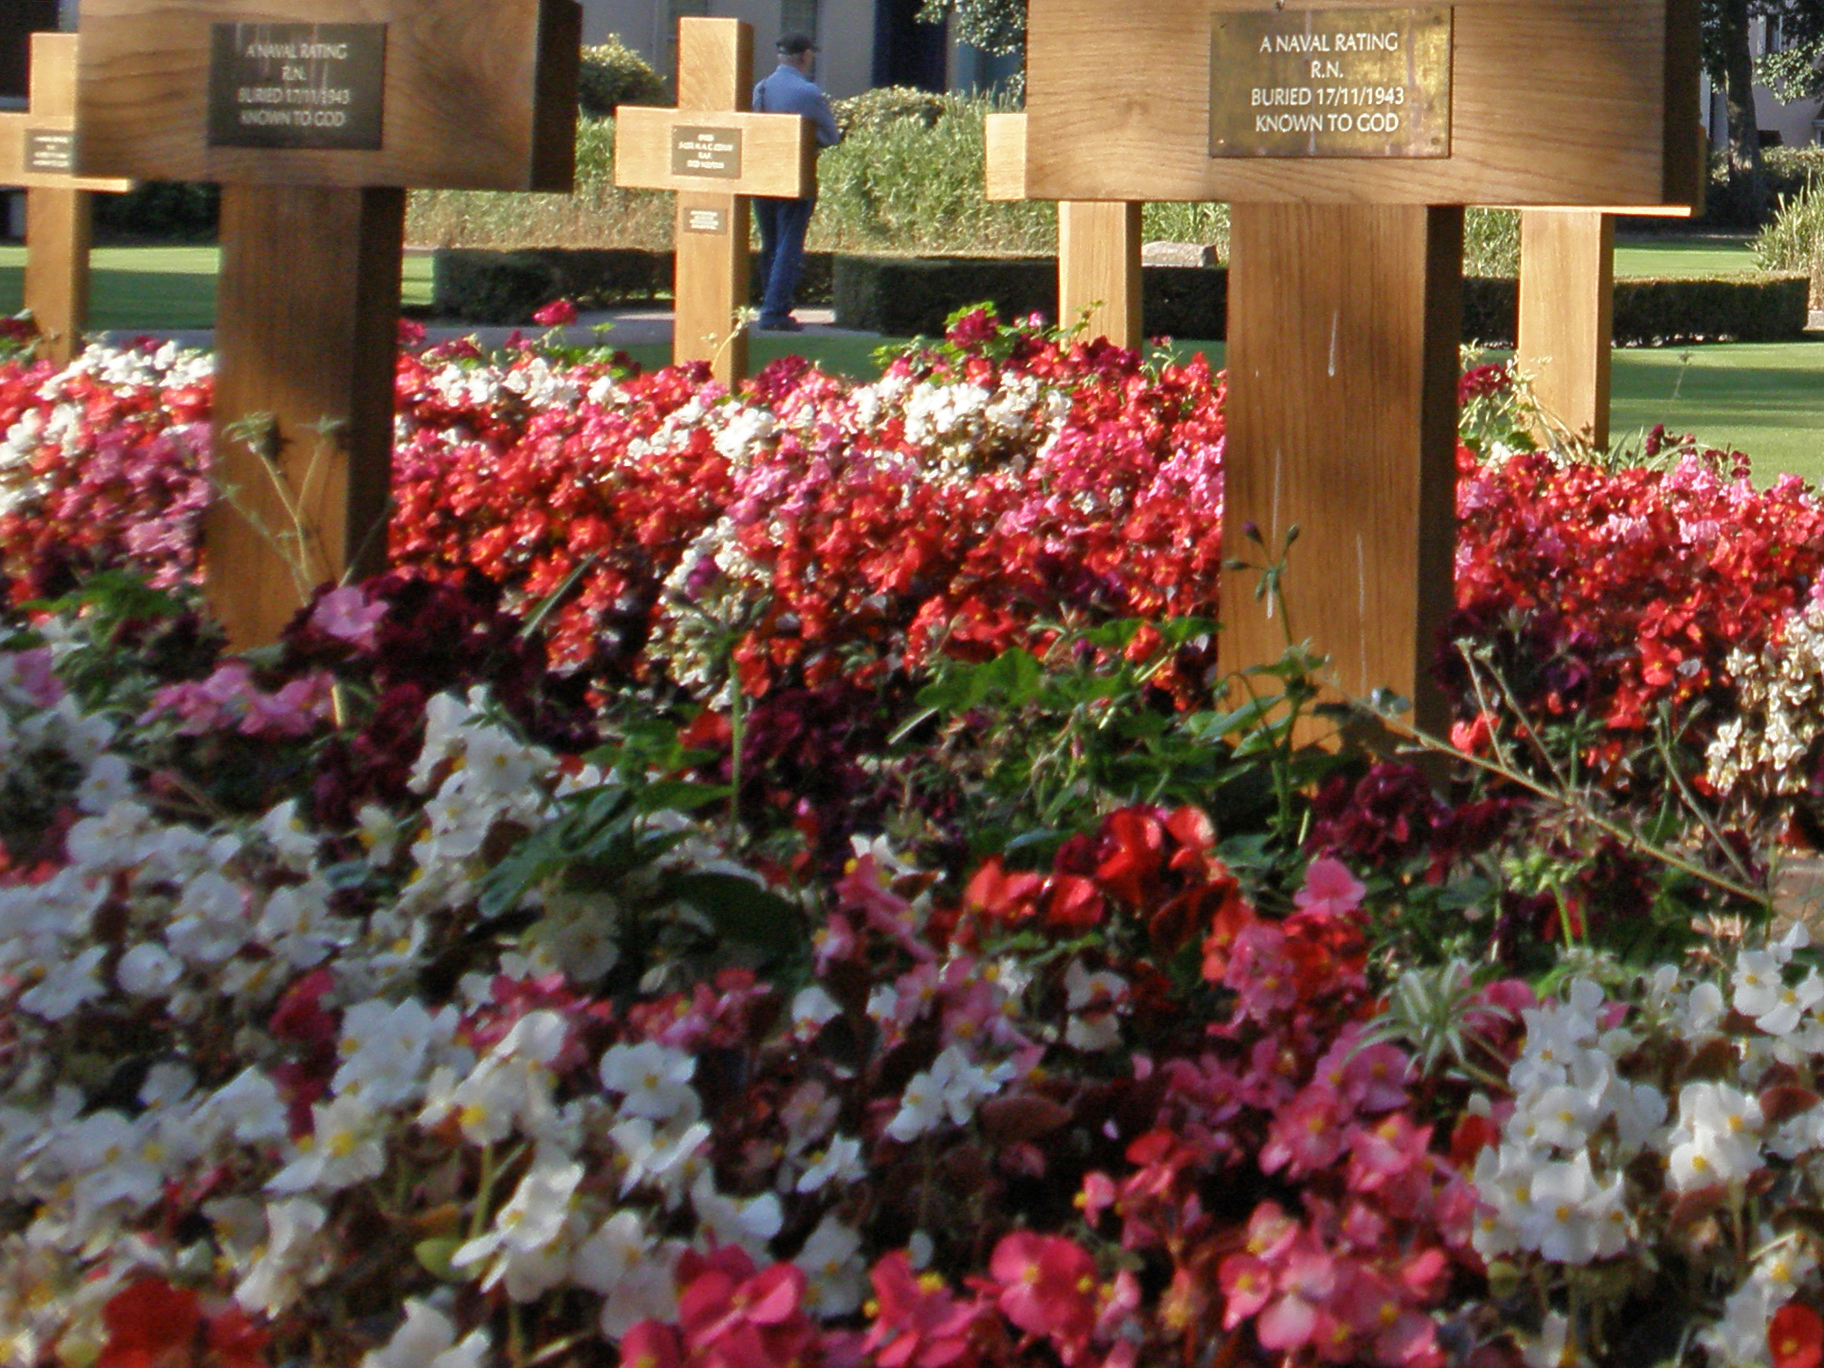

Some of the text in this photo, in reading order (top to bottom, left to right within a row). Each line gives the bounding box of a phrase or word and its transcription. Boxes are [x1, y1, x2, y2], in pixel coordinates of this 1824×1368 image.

[245, 44, 348, 59] A NAVAL RATING
[1260, 33, 1398, 53] A NAVAL RATING
[1311, 61, 1344, 78] R.N.
[238, 88, 282, 103] BURIED
[1252, 87, 1404, 106] BURIED 17/11/1943
[241, 110, 345, 126] KNOWN TO GOD
[1256, 113, 1398, 132] KNOWN TO GOD
